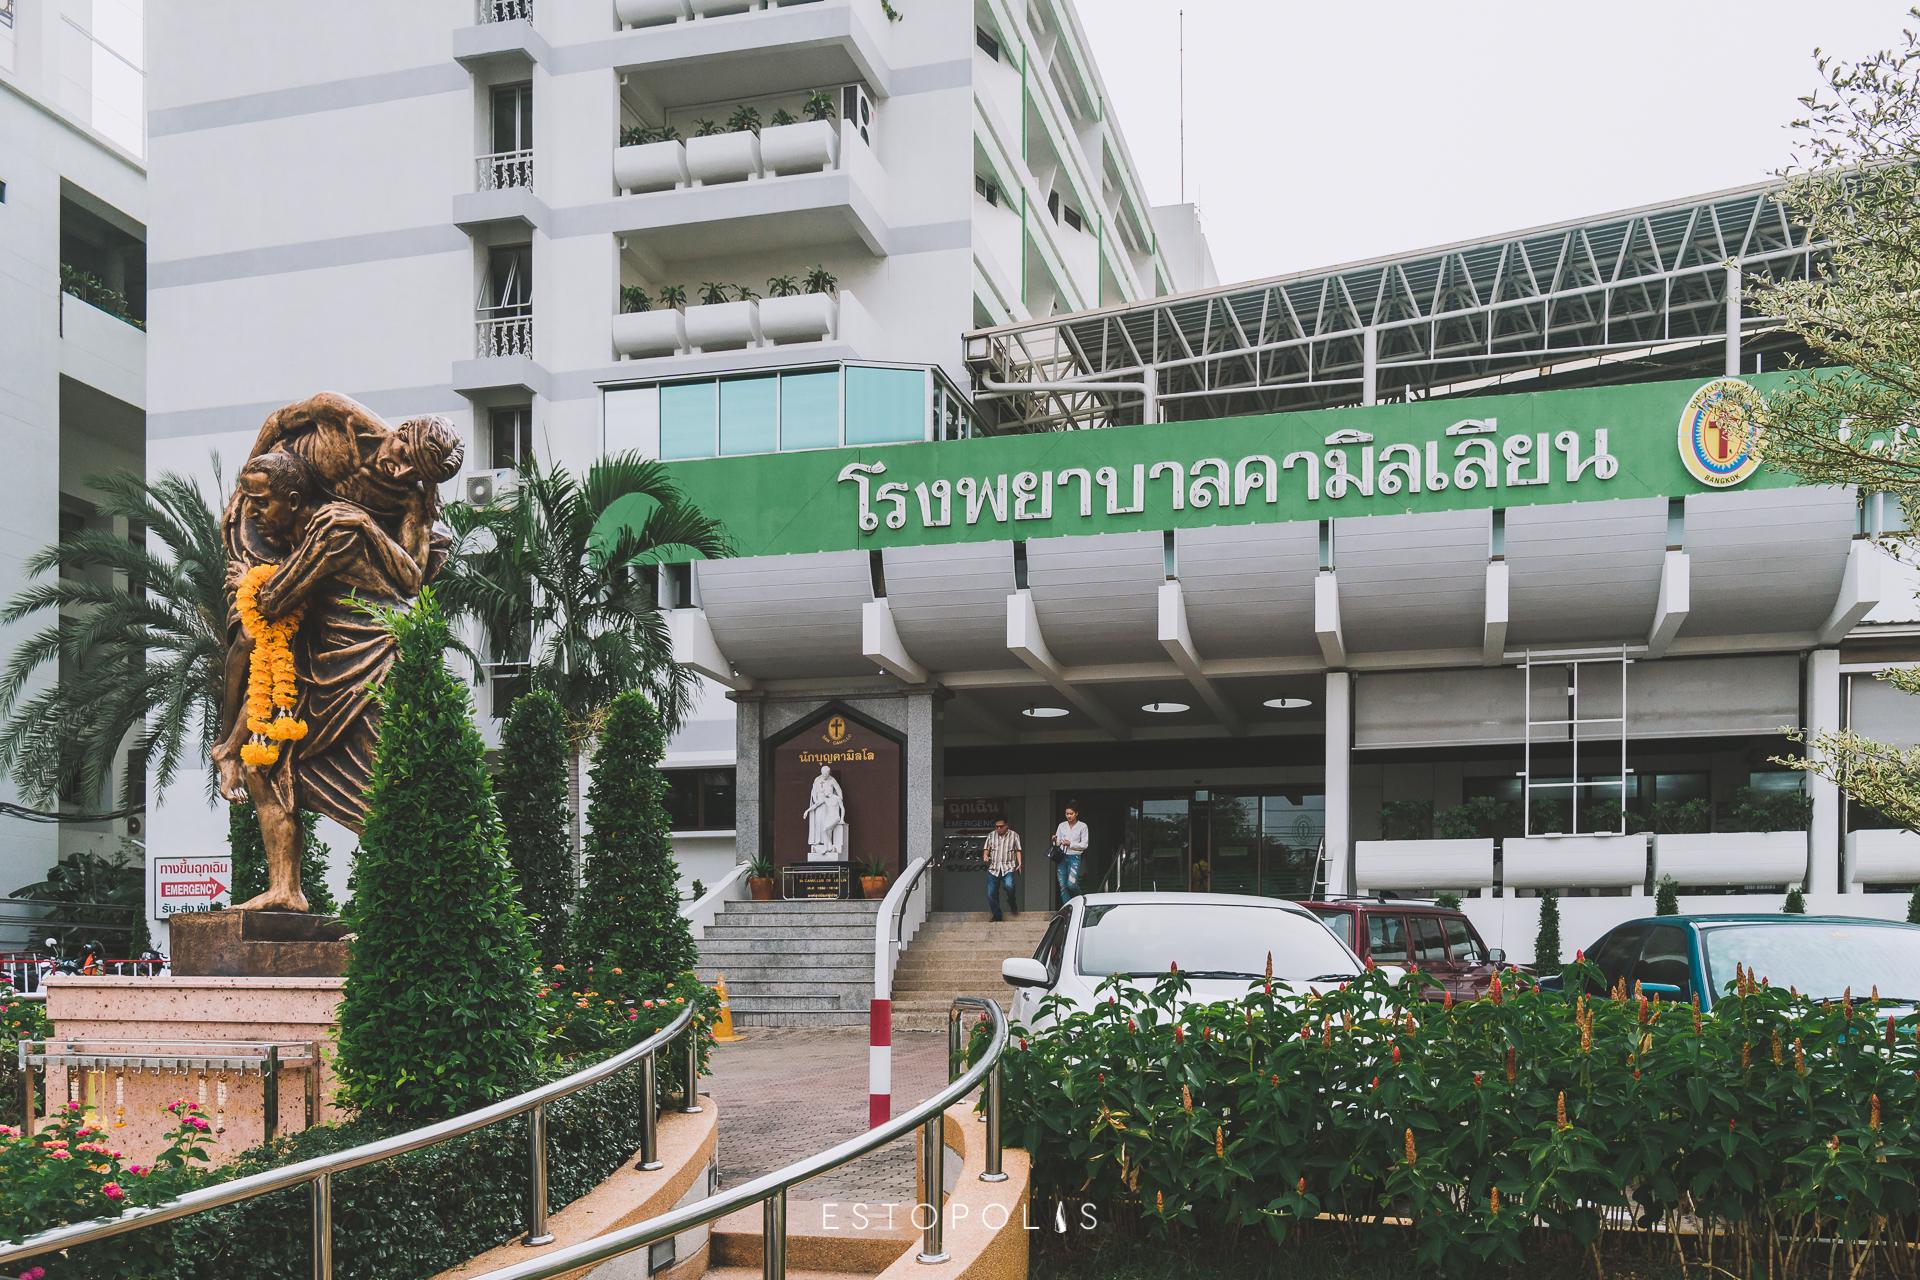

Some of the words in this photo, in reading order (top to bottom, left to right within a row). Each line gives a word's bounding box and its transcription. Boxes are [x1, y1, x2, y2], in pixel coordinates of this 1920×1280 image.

[837, 417, 1618, 533] โรงพยาบาลคามิลเลียน
[1704, 474, 1741, 484] BANGKOK
[799, 748, 875, 766] นักบุญคามิลโล
[945, 819, 997, 827] EMERGENC
[161, 859, 228, 877] ทางขึ้นฉุกเฉิน
[165, 883, 218, 896] EMERGENCY
